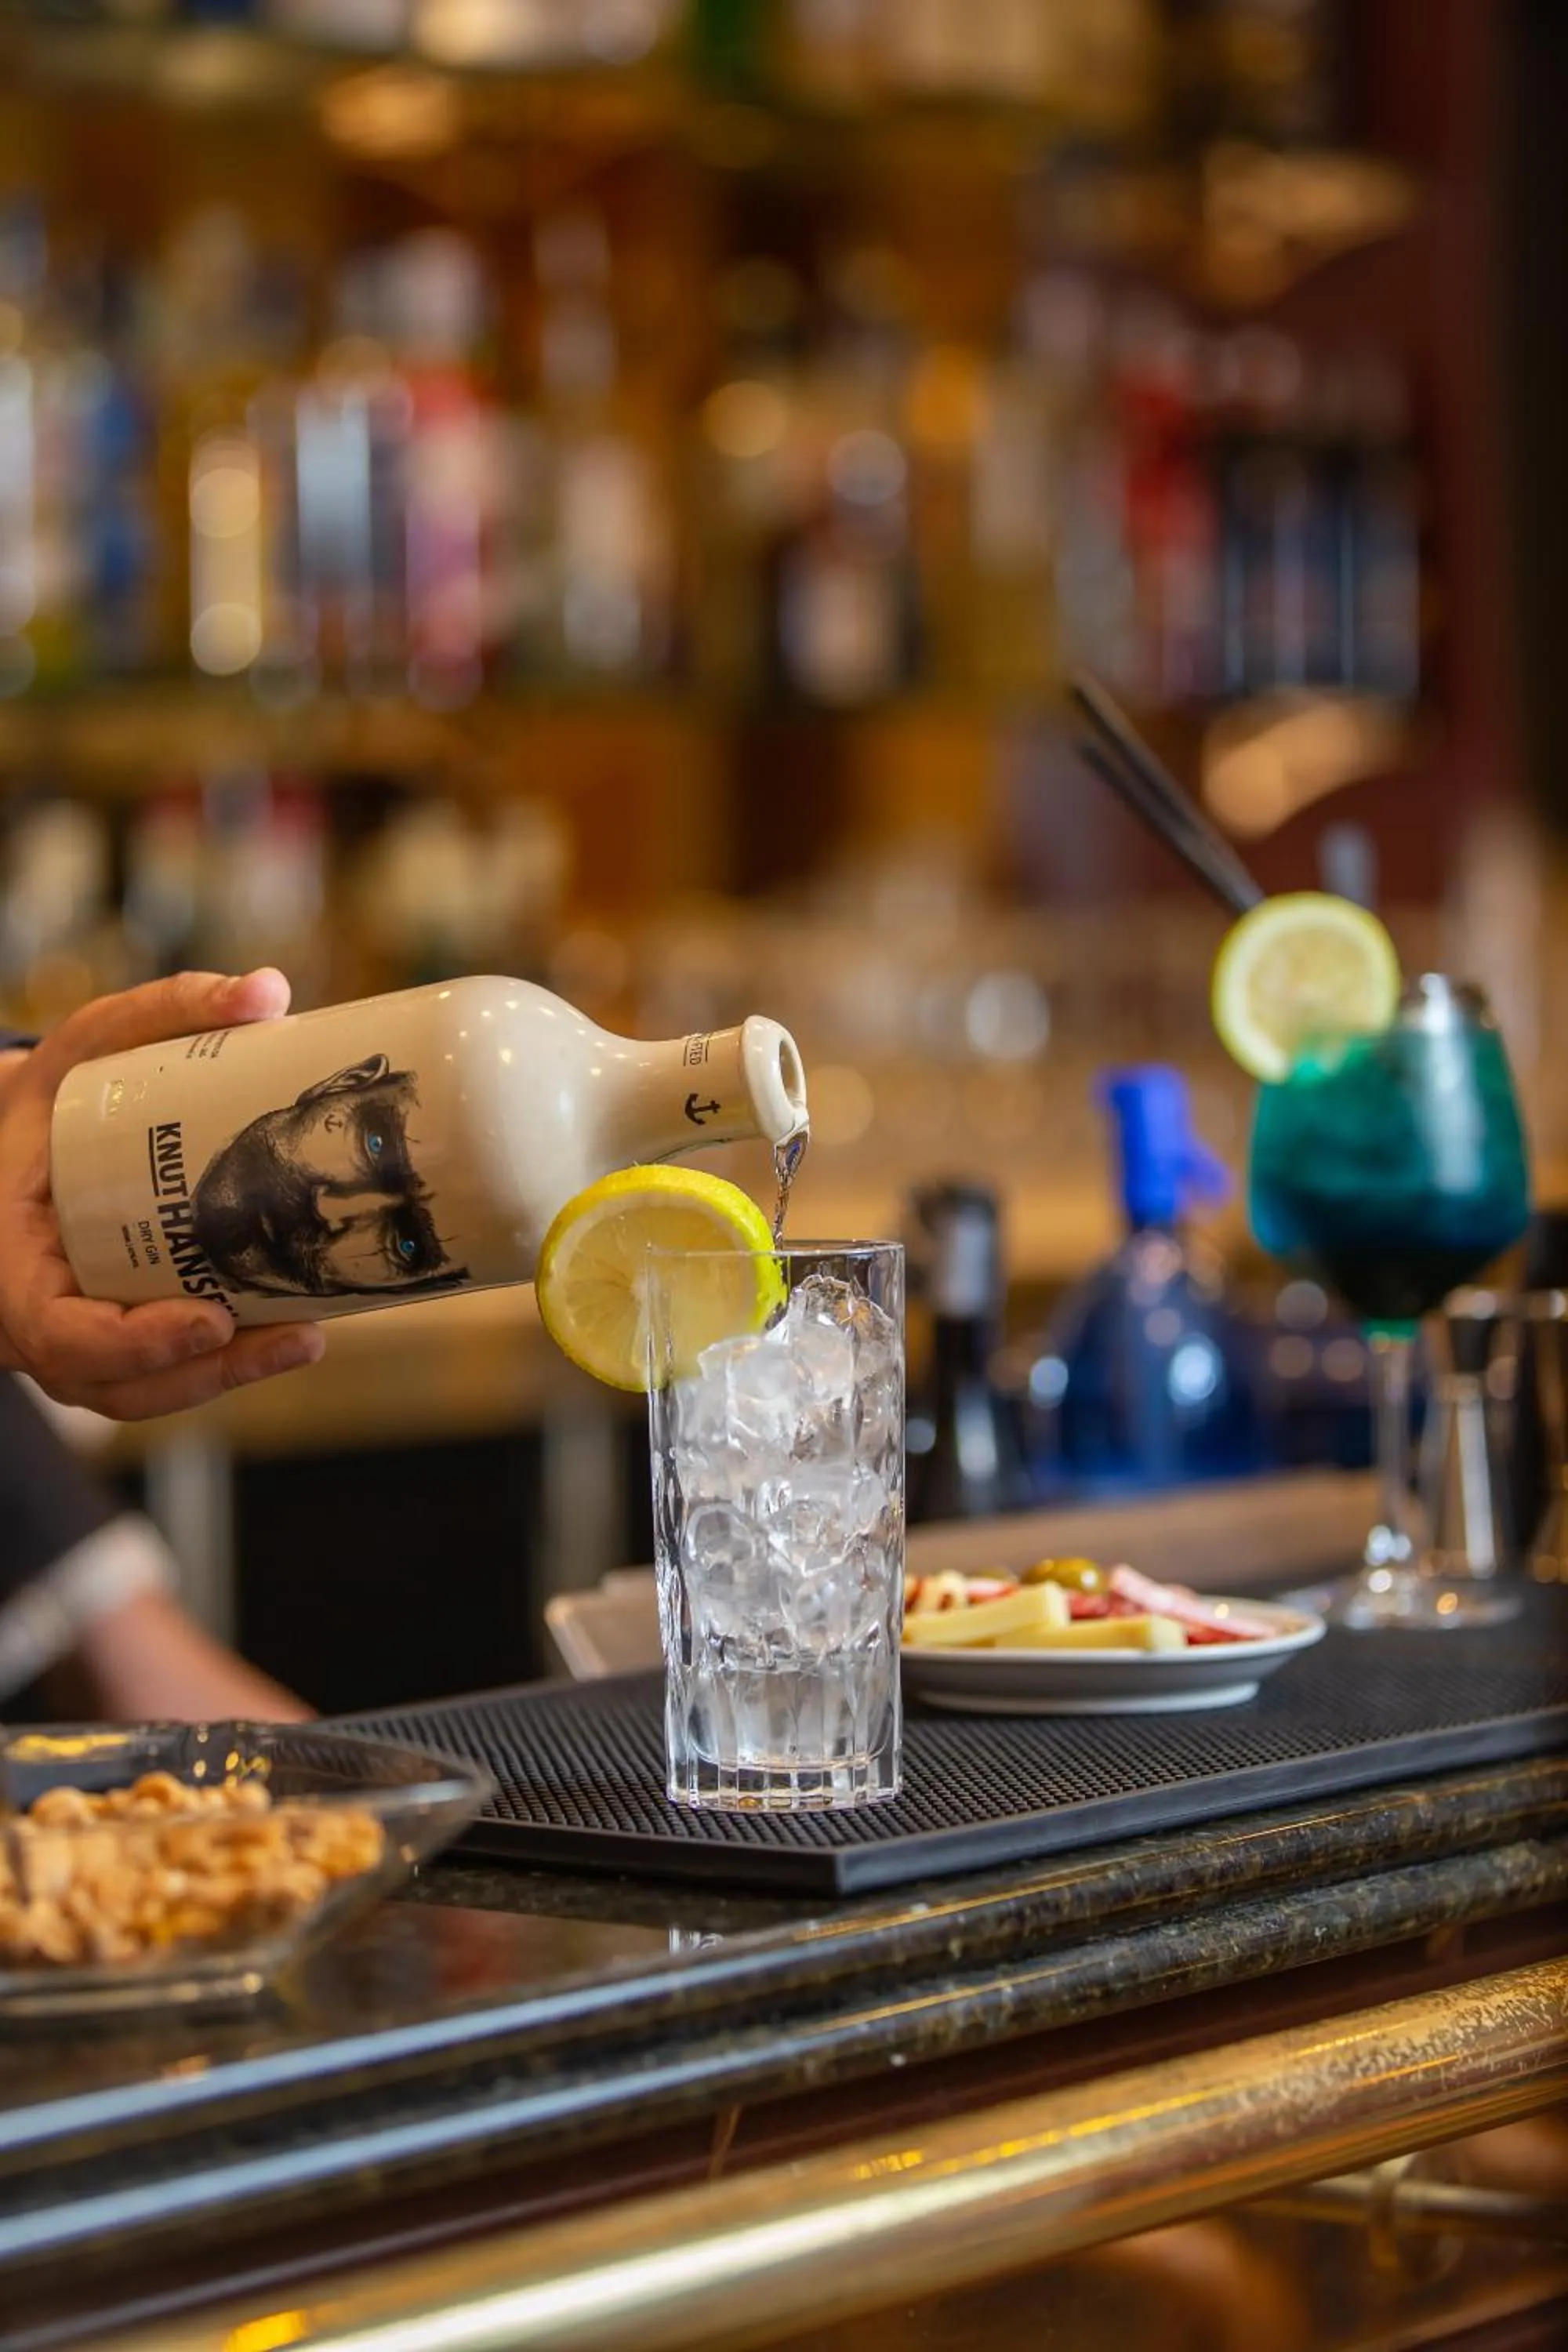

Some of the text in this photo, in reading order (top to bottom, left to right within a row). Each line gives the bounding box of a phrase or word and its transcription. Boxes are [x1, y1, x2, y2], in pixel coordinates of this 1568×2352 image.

[157, 1122, 188, 1196] KNUT
[138, 1220, 161, 1265] DRY GIN
[158, 1200, 238, 1317] HANSE
